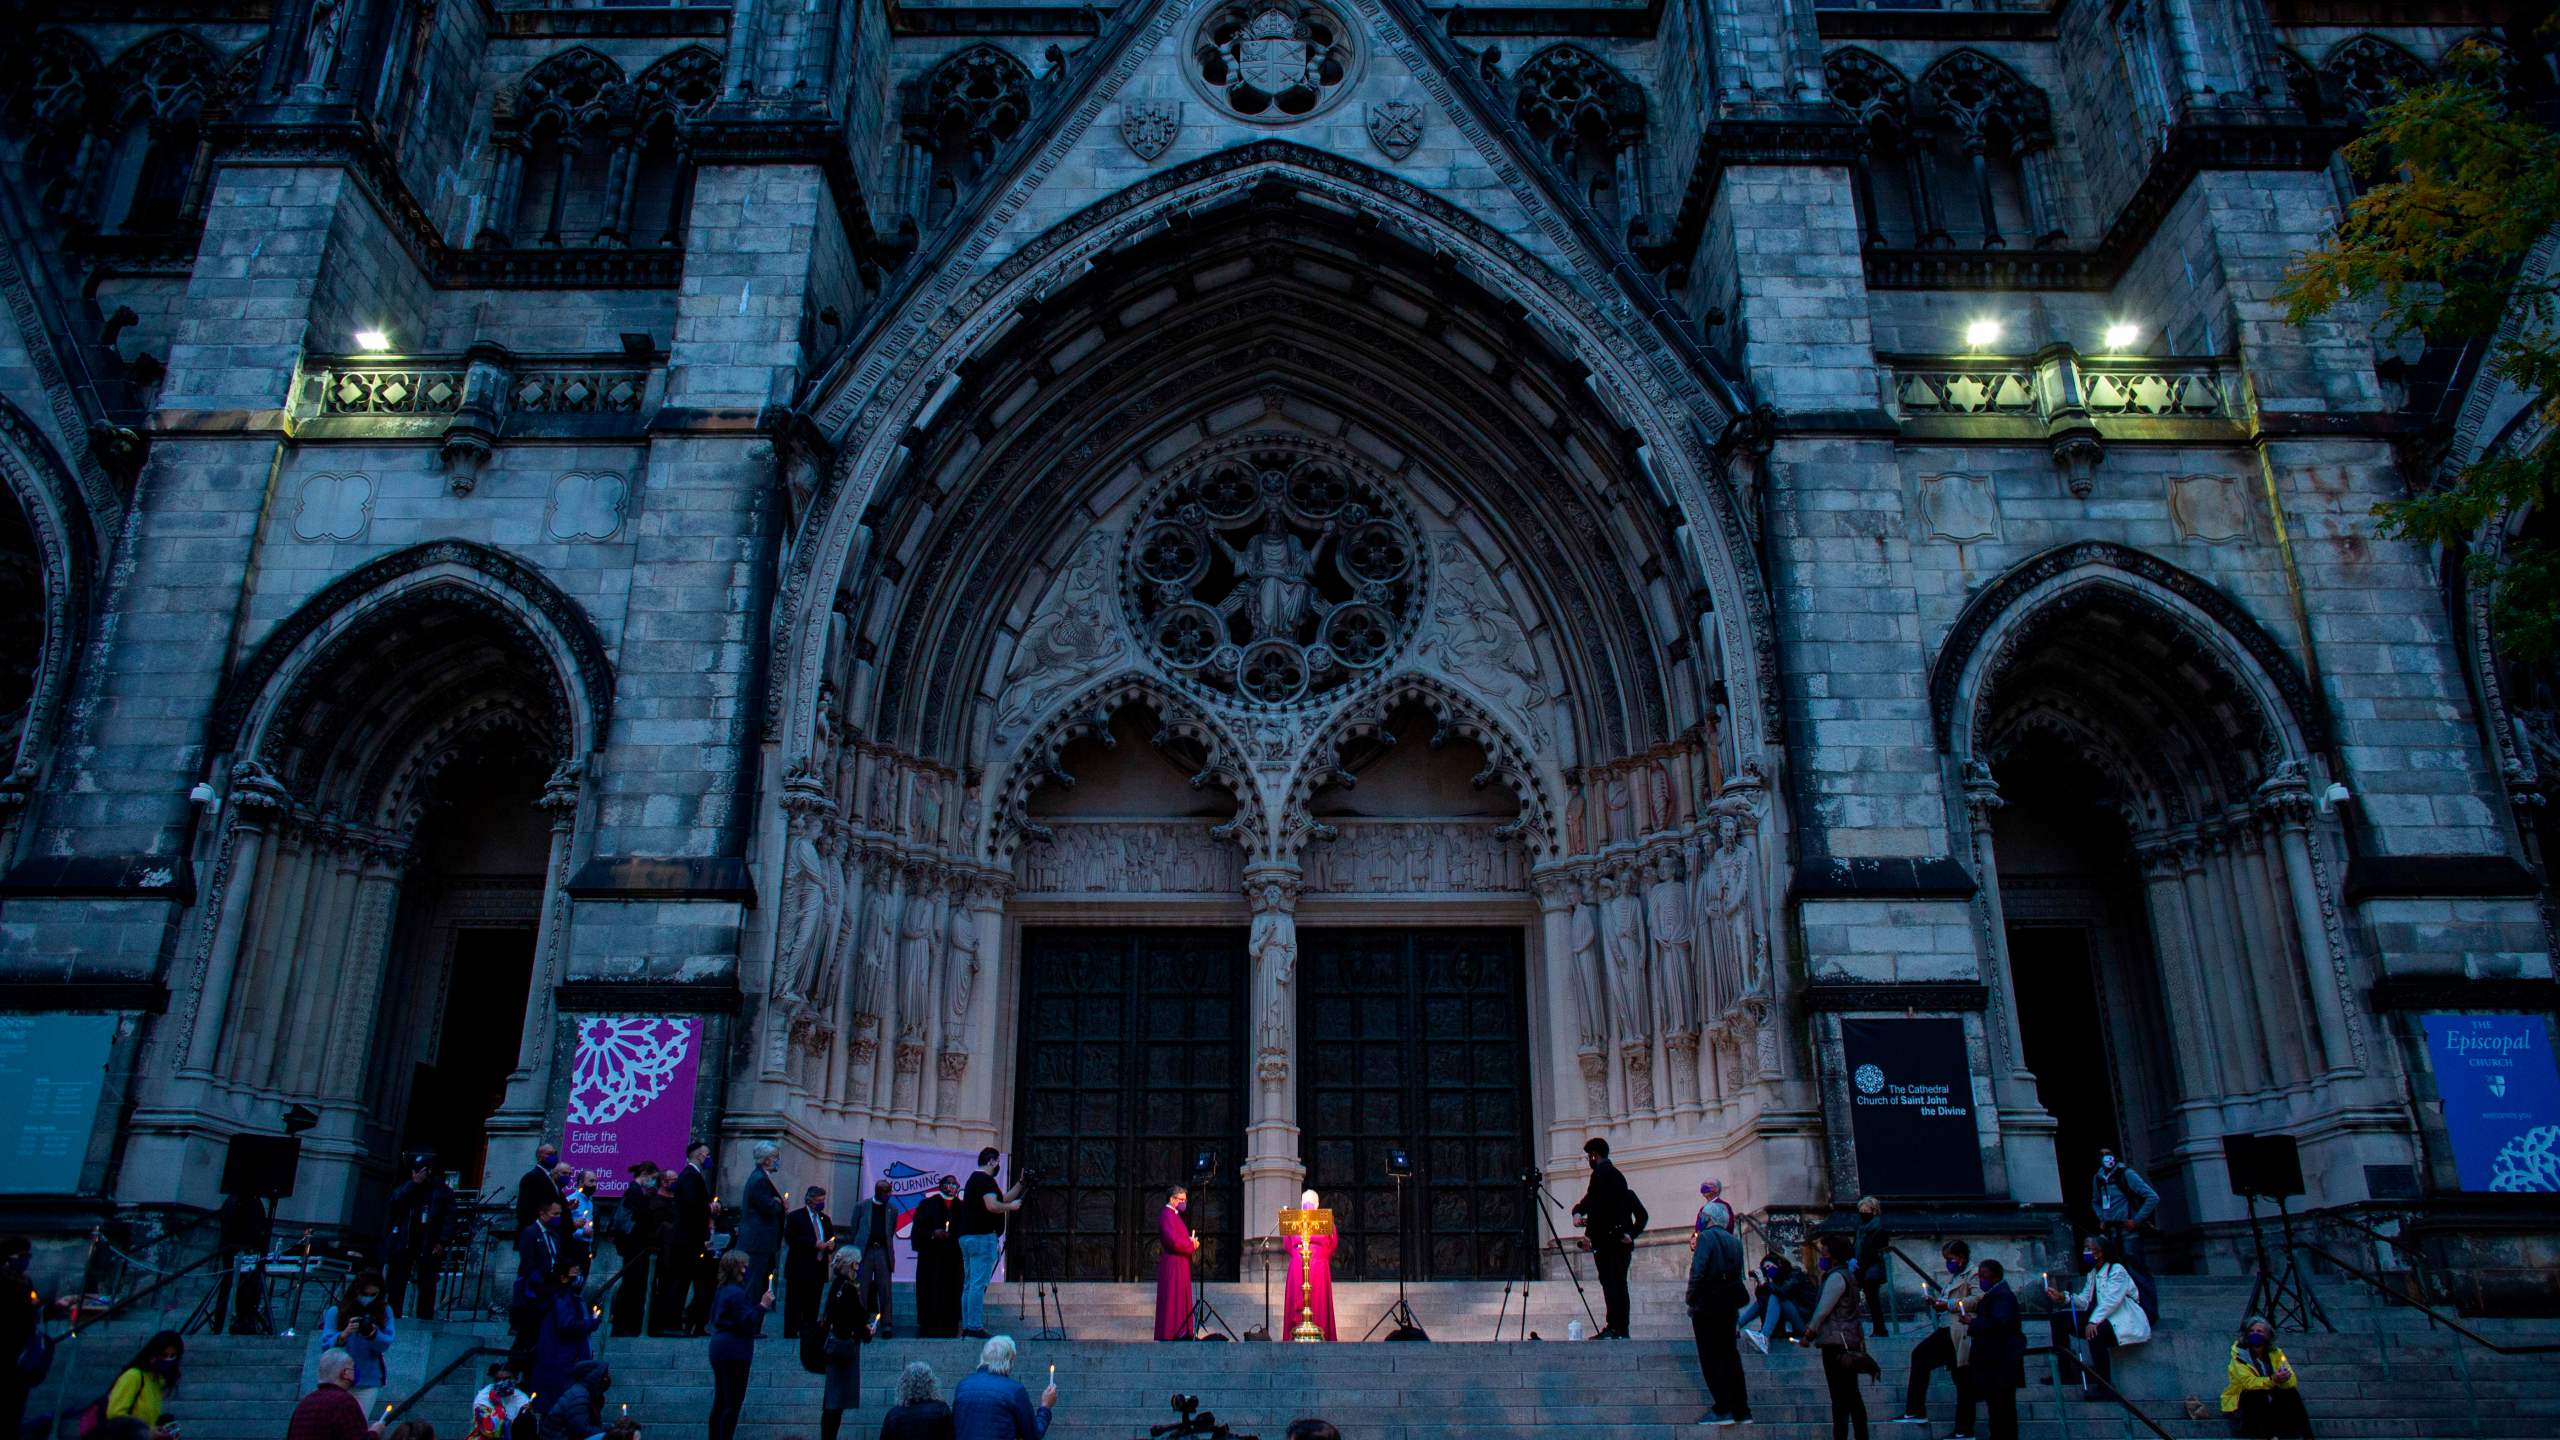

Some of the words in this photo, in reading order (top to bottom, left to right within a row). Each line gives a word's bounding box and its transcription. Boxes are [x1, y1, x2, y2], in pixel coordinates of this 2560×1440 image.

[2471, 1020, 2492, 1029] THE
[2446, 1029, 2530, 1056] Episcopal
[2468, 1058, 2513, 1067] CHURCH
[1889, 1084, 1906, 1094] The
[1907, 1084, 1949, 1094] Cathedral
[1857, 1095, 1888, 1105] Church
[1890, 1095, 1899, 1105] of
[1900, 1095, 1925, 1105] Saint
[1926, 1095, 1948, 1105] John
[1920, 1106, 1936, 1116] the
[1937, 1106, 1967, 1116] Divine
[572, 1130, 598, 1142] Enter
[601, 1130, 617, 1142] the
[570, 1142, 619, 1154] Cathedral.
[596, 1167, 612, 1179] the
